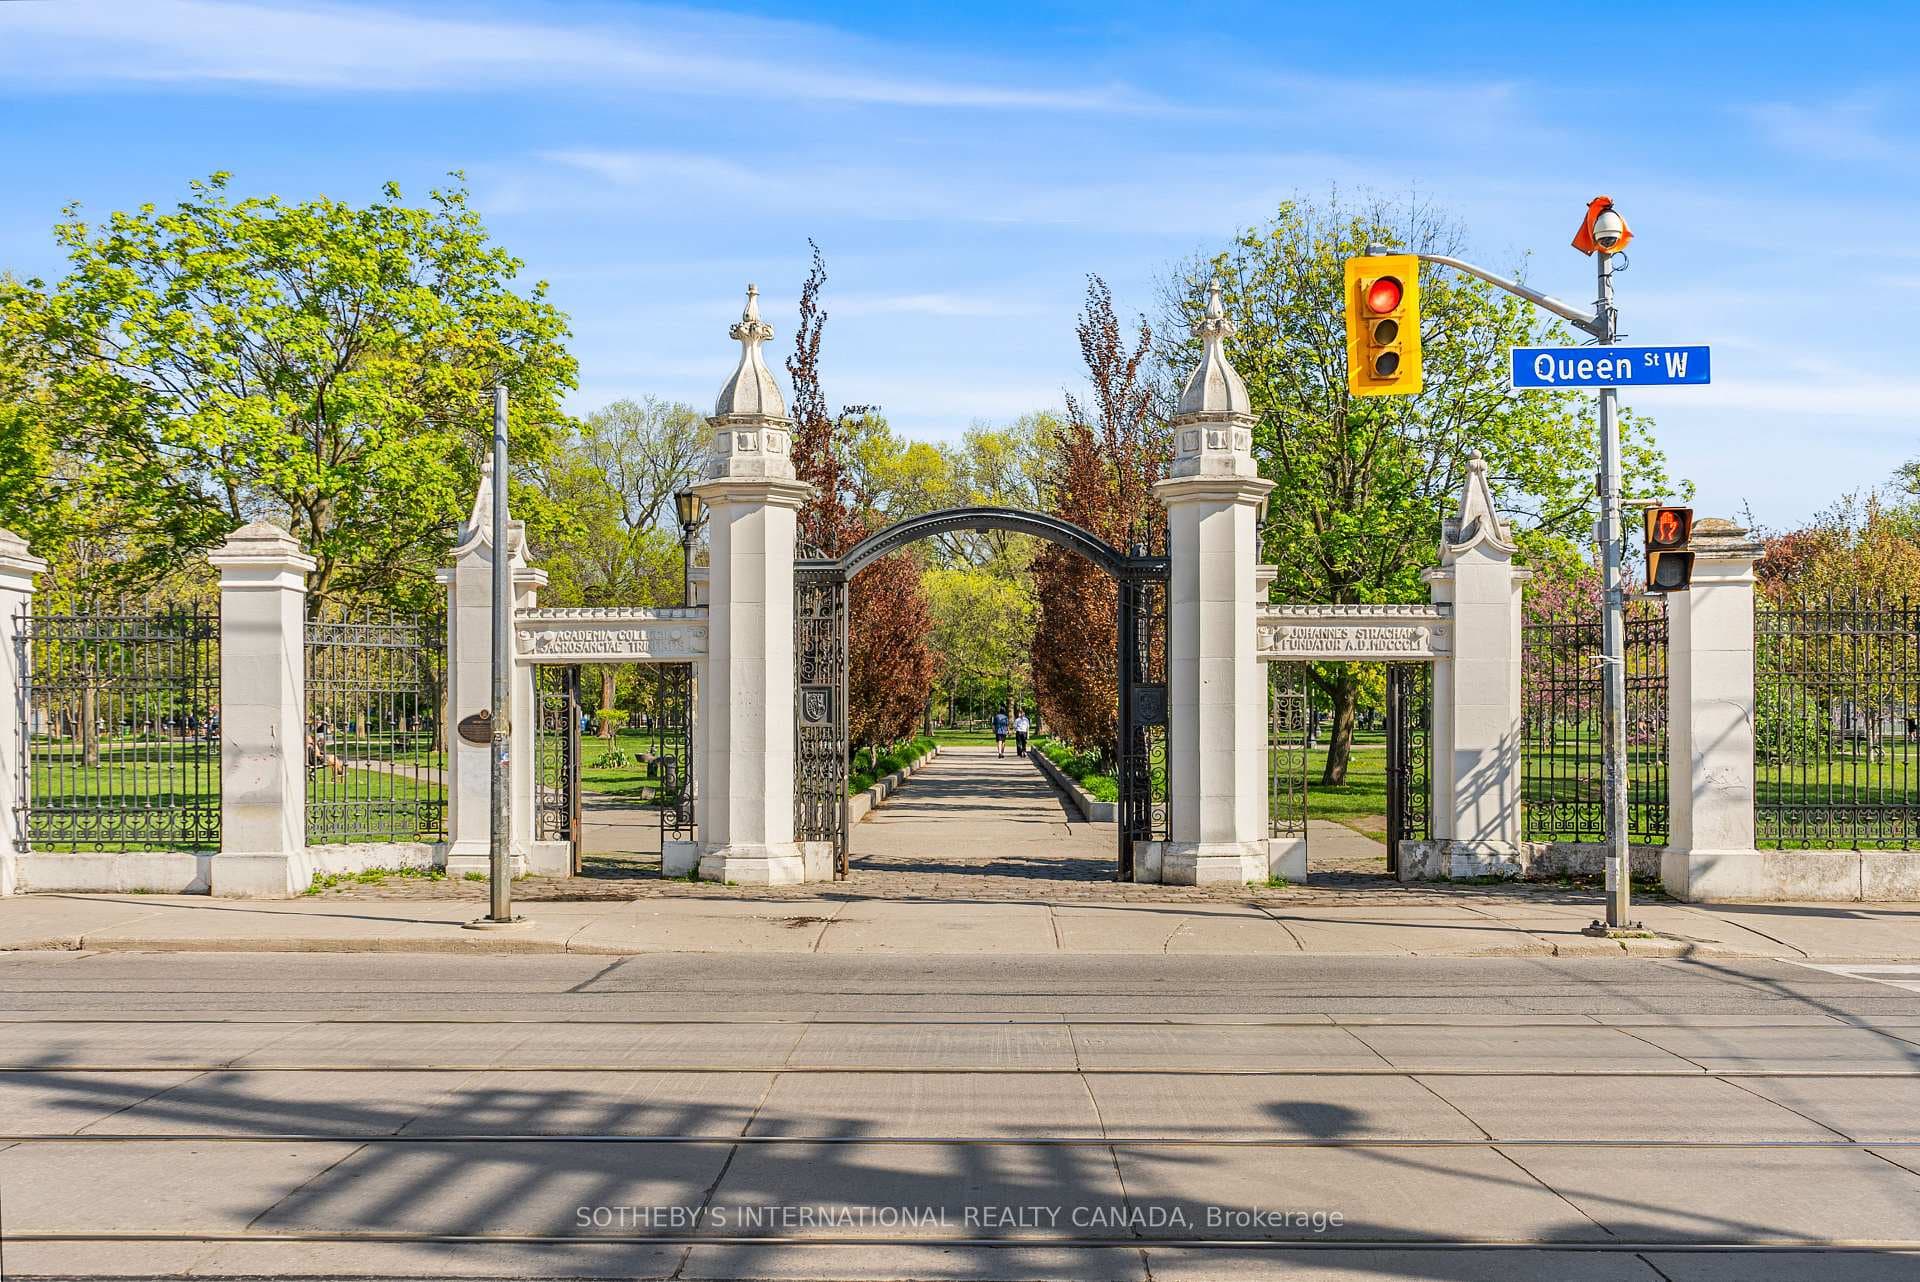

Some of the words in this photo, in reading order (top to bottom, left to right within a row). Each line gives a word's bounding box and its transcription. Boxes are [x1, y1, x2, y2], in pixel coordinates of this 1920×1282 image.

[1534, 353, 1632, 383] Queen
[1644, 352, 1660, 367] St
[1664, 351, 1689, 379] W
[555, 630, 612, 642] ACADEMIA
[1289, 627, 1348, 639] JOHANNES
[1355, 627, 1416, 639] STRACHAN
[1282, 638, 1341, 651] FUNDATOR
